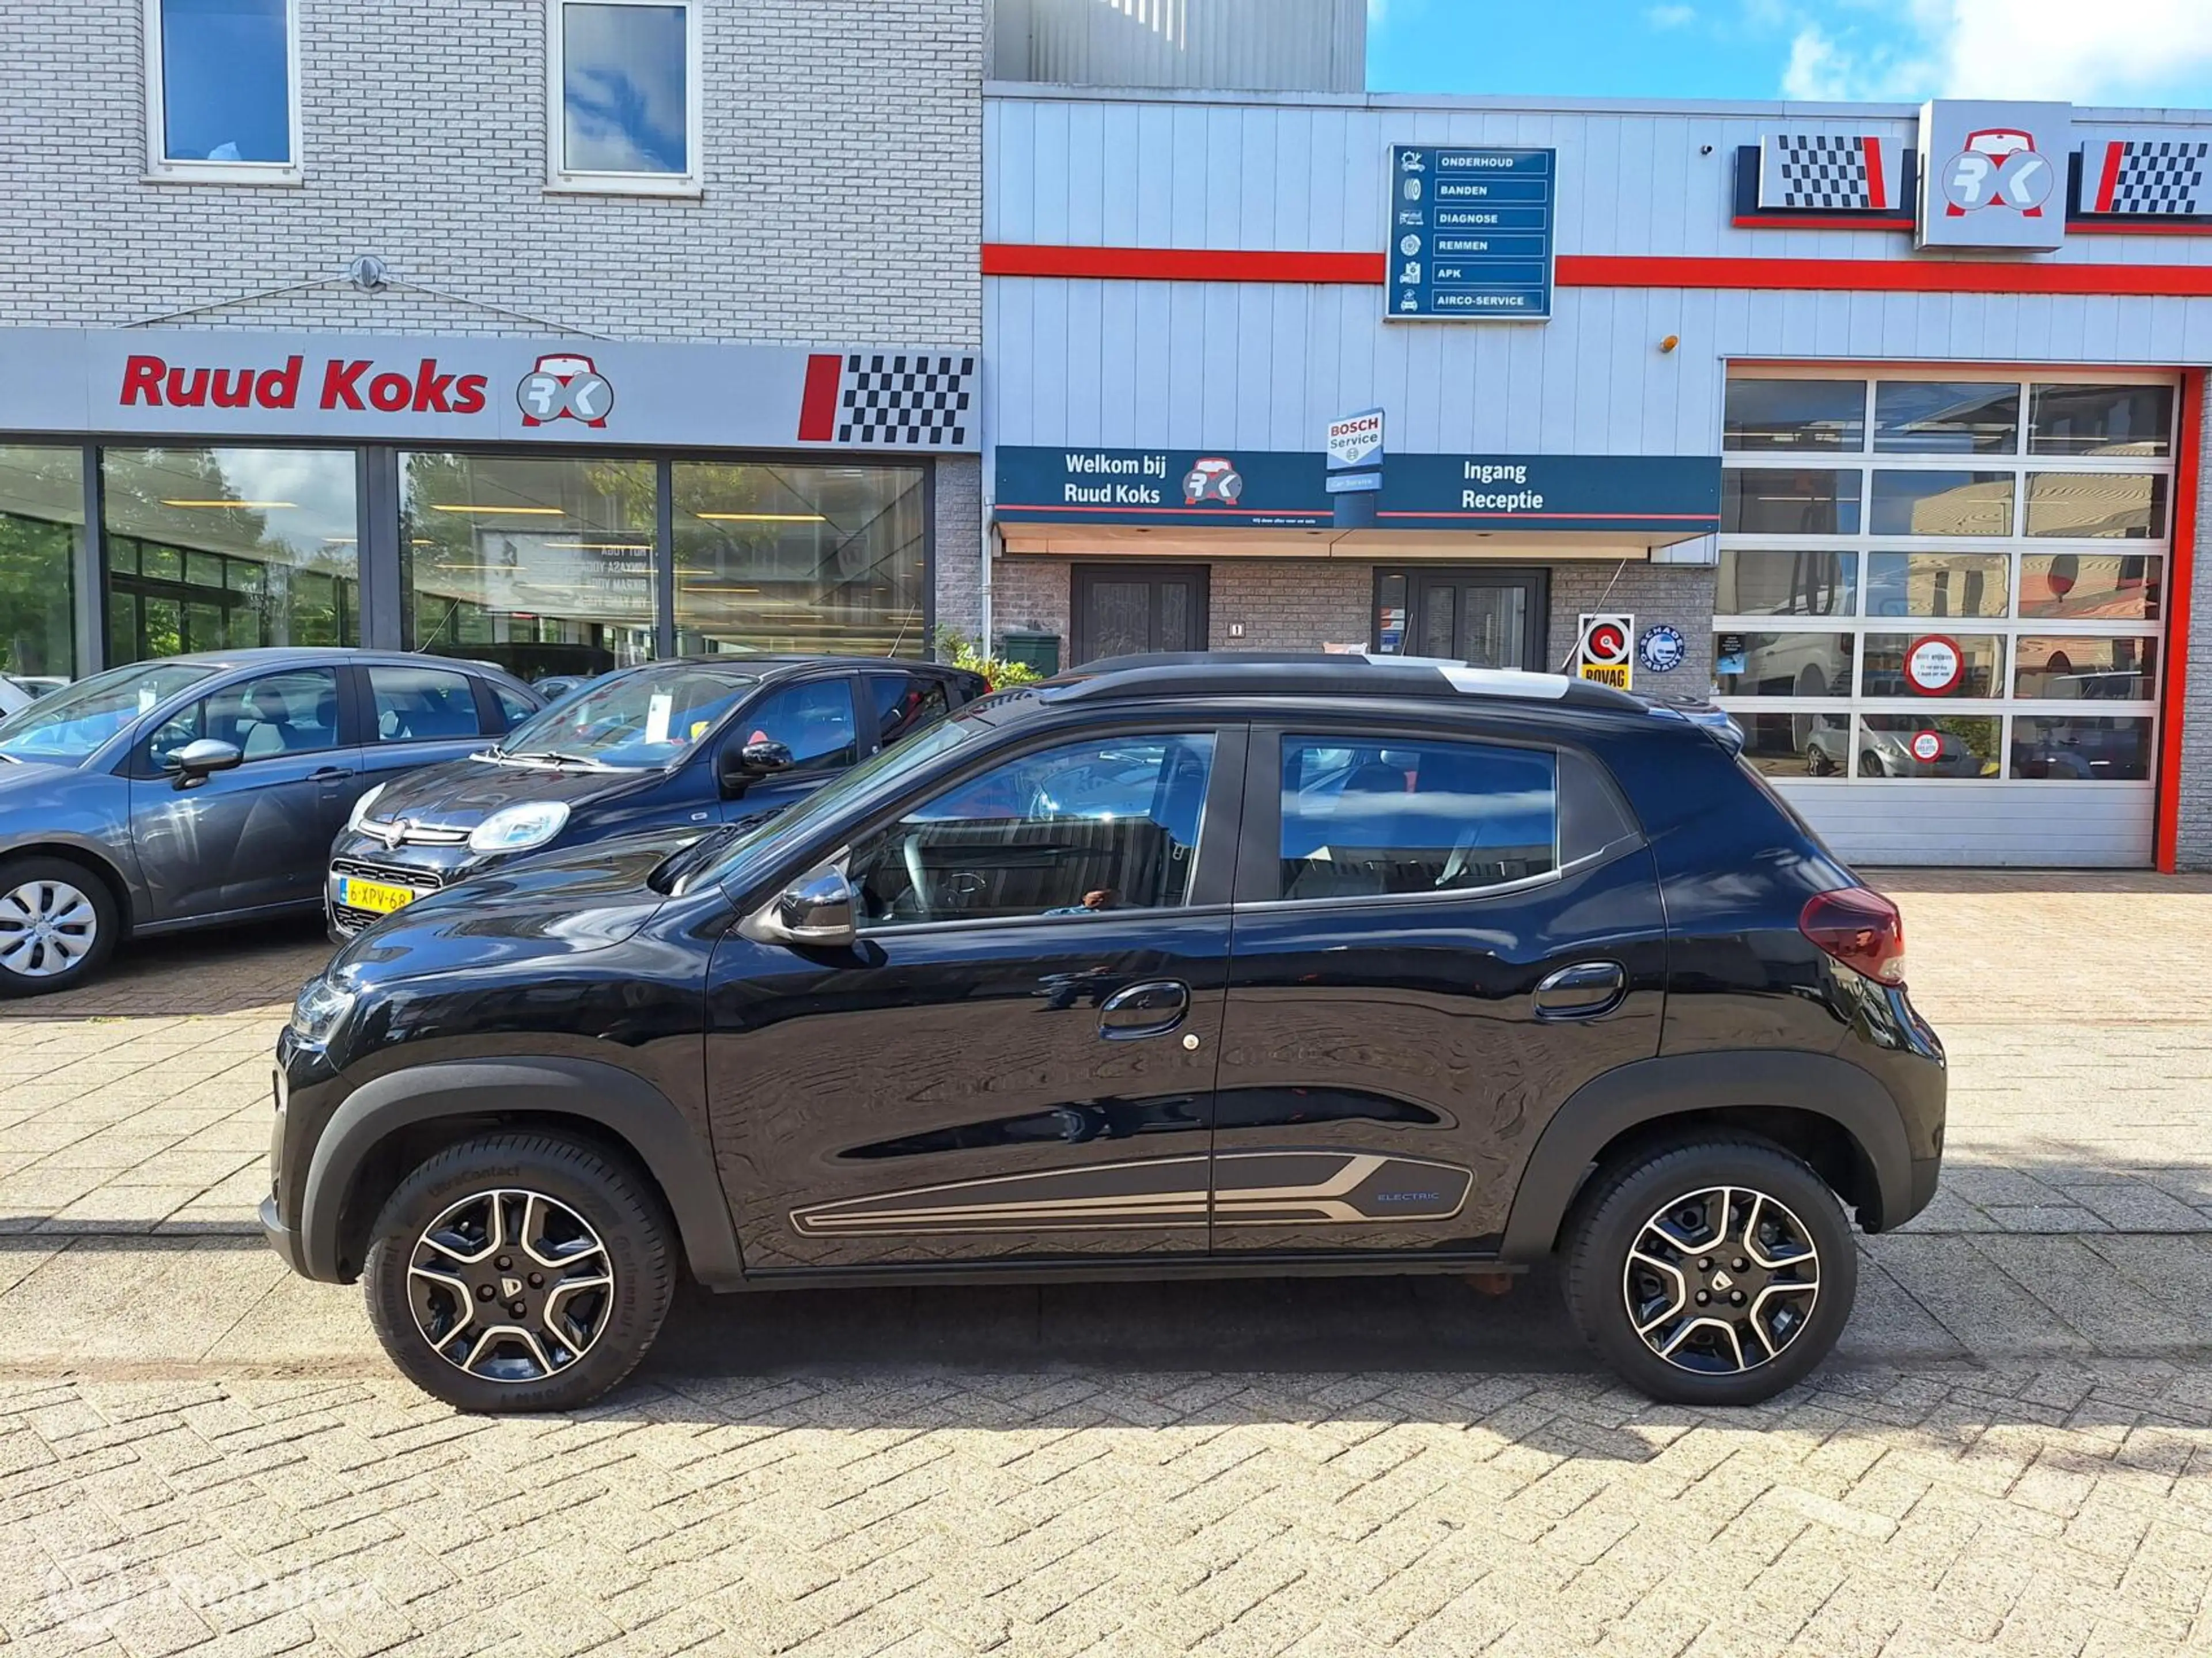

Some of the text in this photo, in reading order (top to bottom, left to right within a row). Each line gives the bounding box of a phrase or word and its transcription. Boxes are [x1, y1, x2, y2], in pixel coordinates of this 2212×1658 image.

[1441, 157, 1513, 167] ONDERHOUD
[1441, 186, 1487, 195] BANDEN
[1440, 214, 1498, 223] DIAGNOSE
[1439, 241, 1488, 250] REMMEN
[1438, 269, 1461, 278] APK
[1437, 296, 1525, 305] AIRCO-SERVICE
[120, 355, 488, 414] Ruud Koks
[1331, 418, 1378, 437] BOSCH
[1330, 434, 1378, 449] Service
[1066, 454, 1166, 479] Welkom bij
[1464, 461, 1527, 483] Ingang
[1065, 483, 1160, 503] Ruud Koks
[1462, 490, 1543, 513] Receptie
[1640, 627, 1684, 646] SCHADE
[1586, 669, 1625, 688] BOVAG
[350, 884, 407, 909] 6-XPV-68
[1377, 1192, 1440, 1201] ELECTRIC
